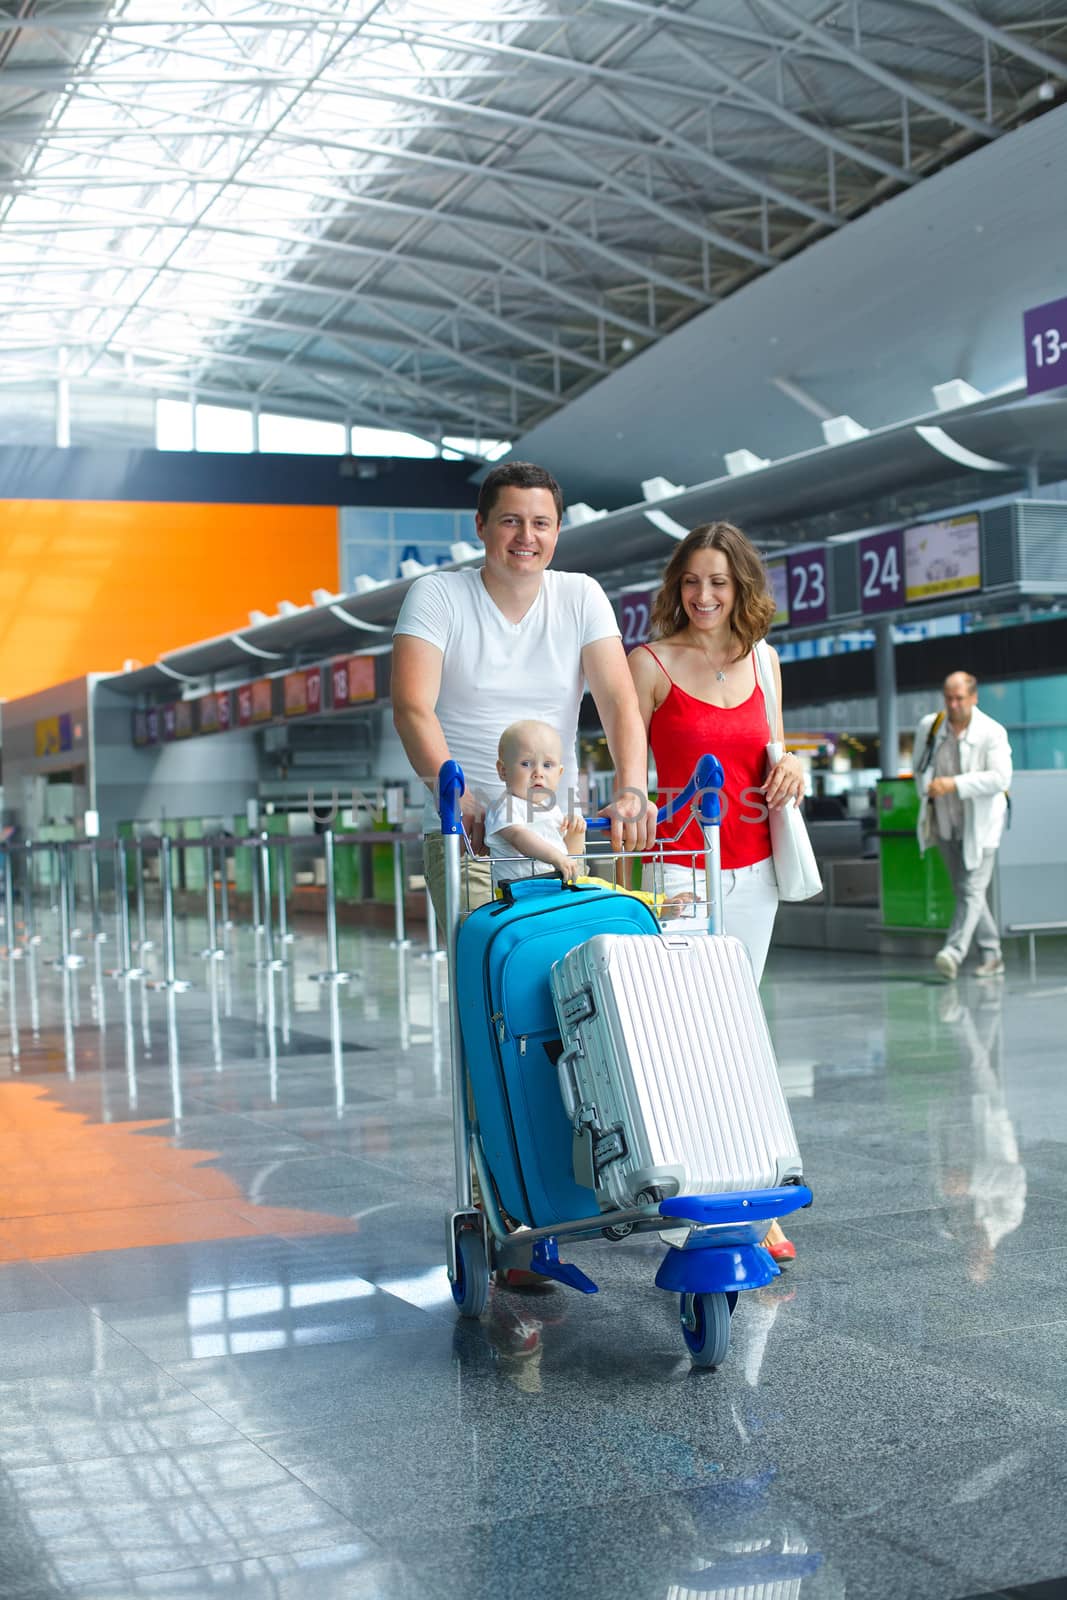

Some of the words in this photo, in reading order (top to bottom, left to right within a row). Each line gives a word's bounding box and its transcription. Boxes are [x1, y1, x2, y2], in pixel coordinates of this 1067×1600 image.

[792, 562, 825, 610] 23
[863, 546, 900, 597] 24
[624, 603, 649, 644] 22
